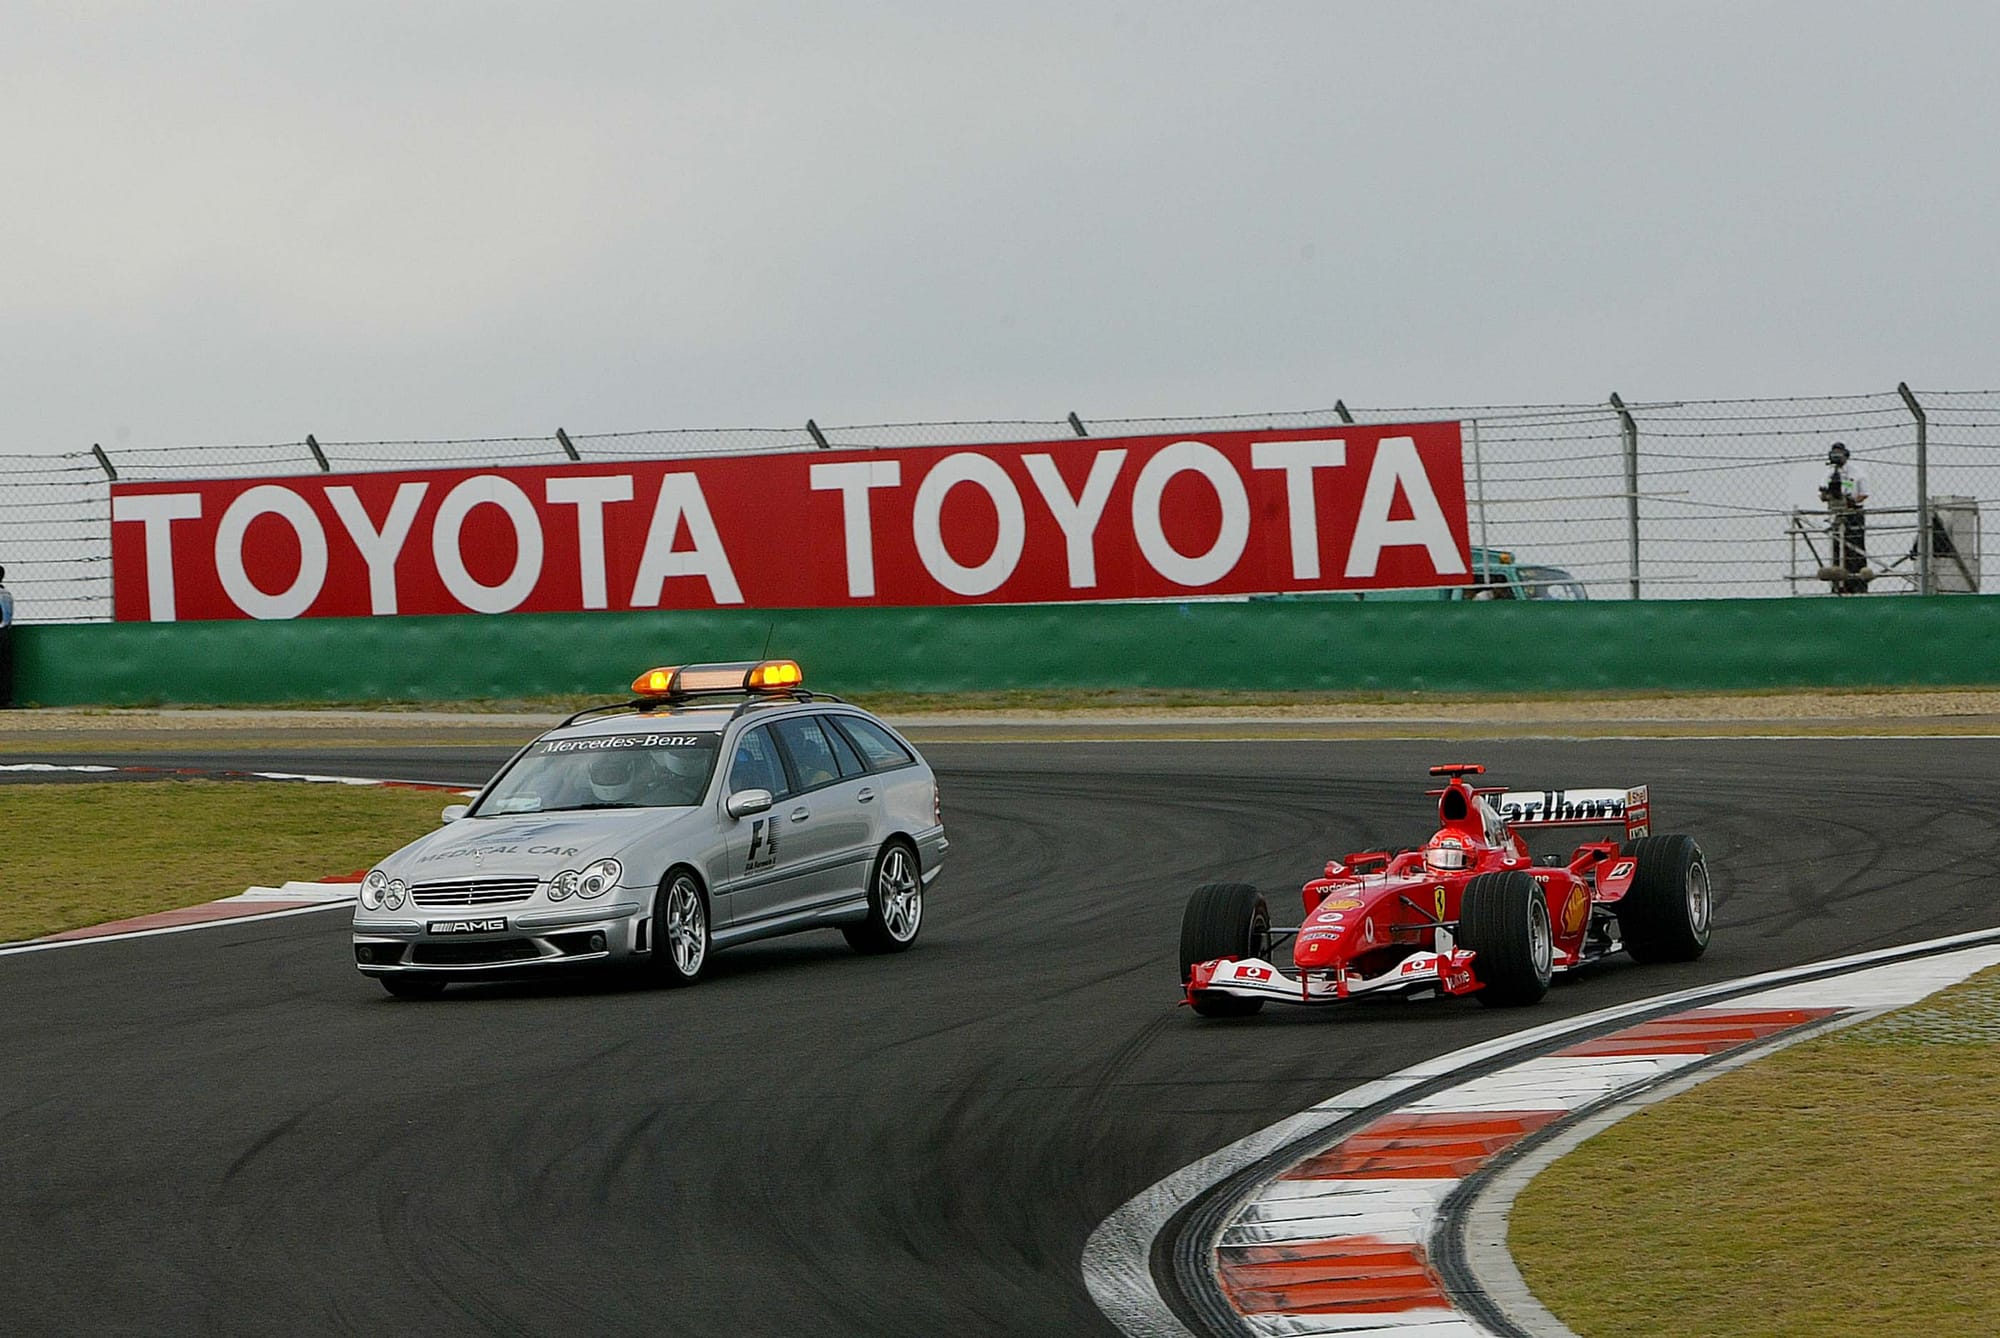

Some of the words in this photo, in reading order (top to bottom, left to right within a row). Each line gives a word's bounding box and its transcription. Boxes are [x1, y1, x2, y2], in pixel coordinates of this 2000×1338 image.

[113, 471, 745, 622] TOYOTA
[810, 436, 1467, 598] TOYOTA
[541, 734, 698, 754] Mercedes-Benz
[528, 845, 579, 858] CAR
[452, 919, 505, 933] AMG
